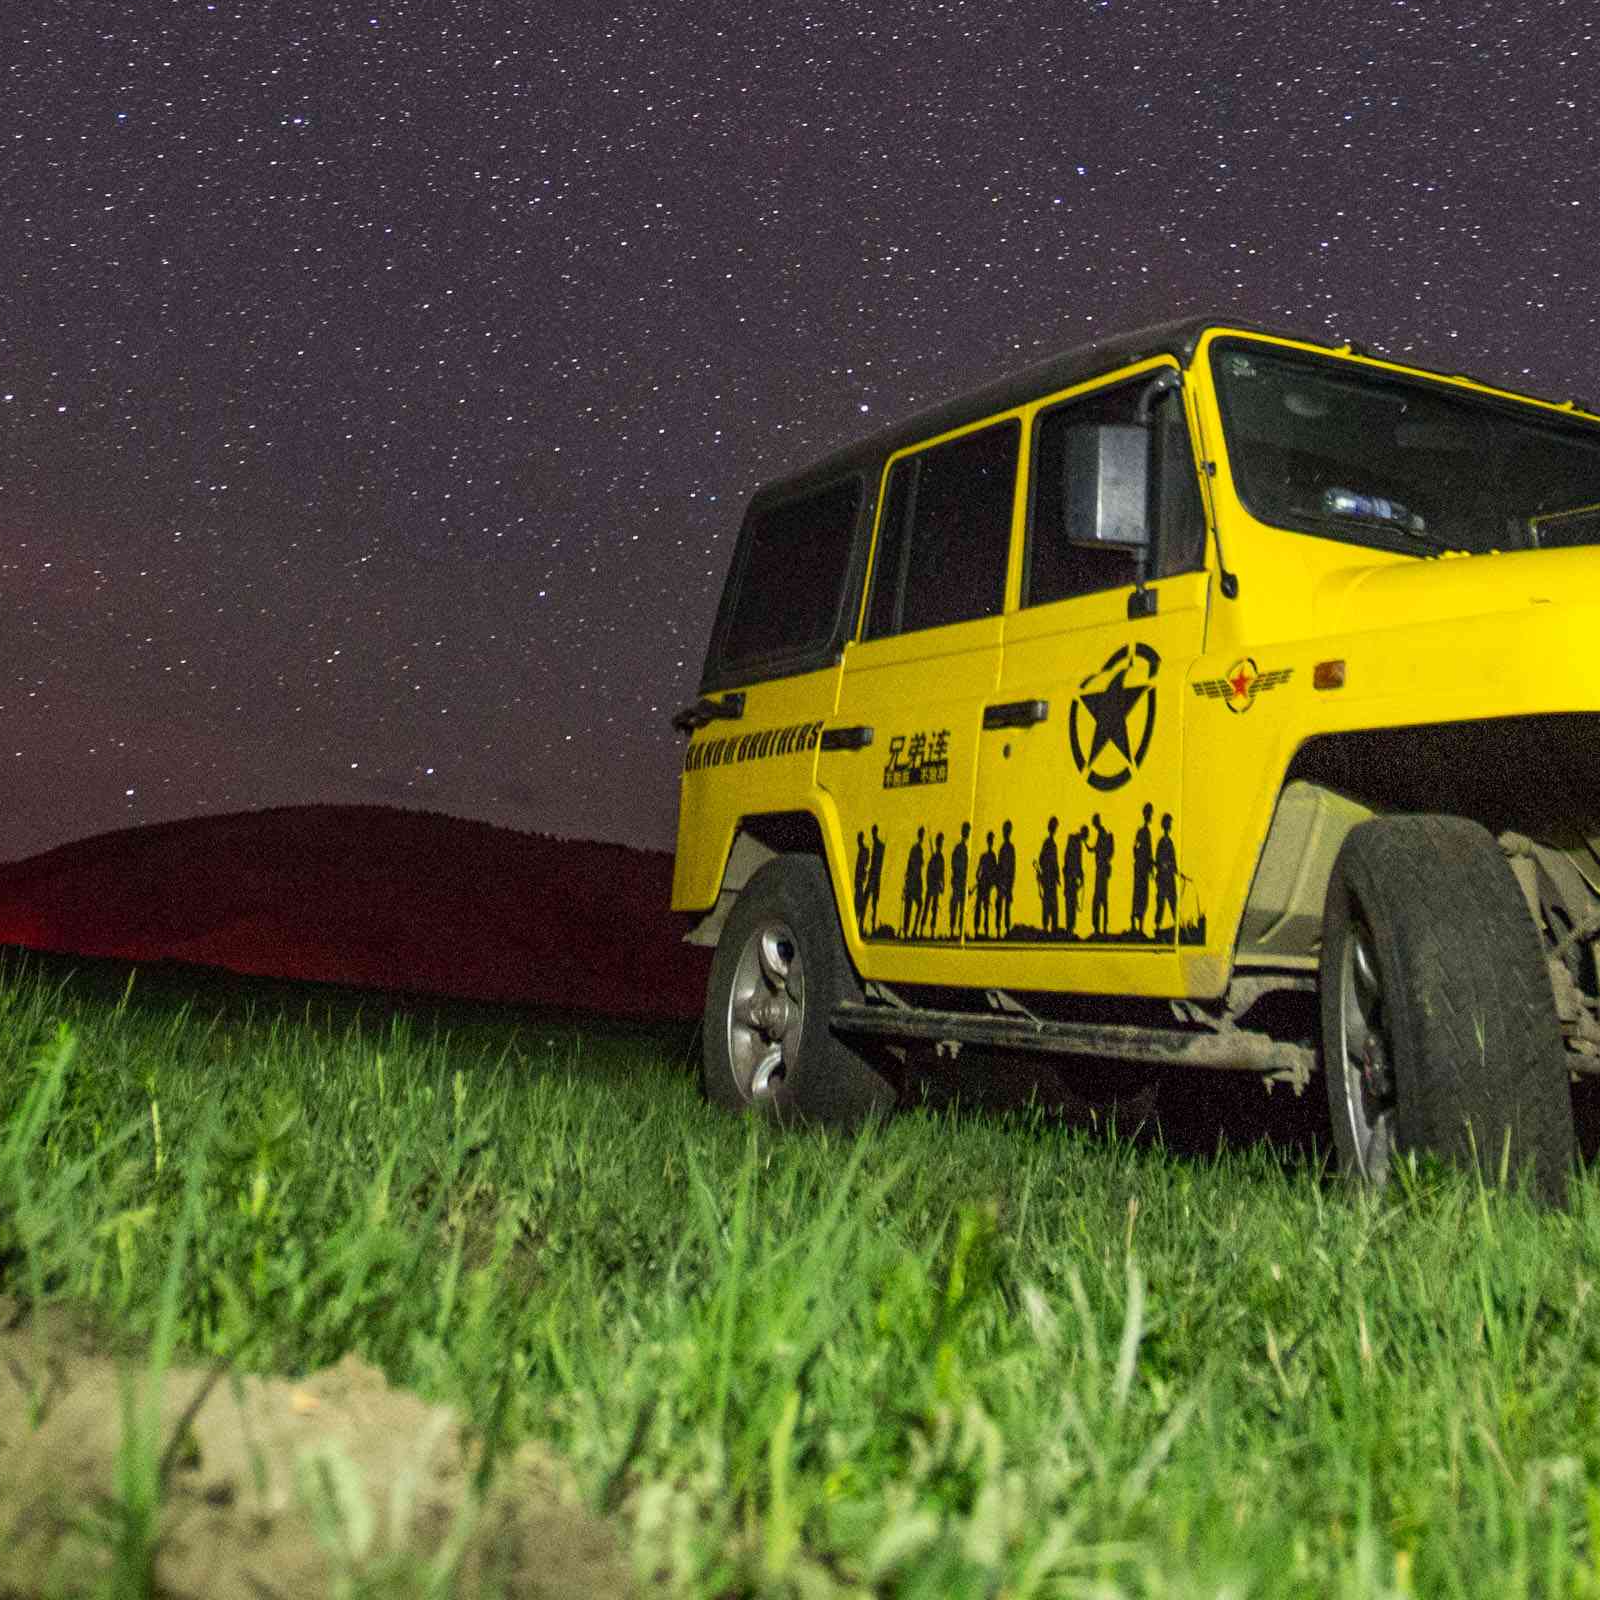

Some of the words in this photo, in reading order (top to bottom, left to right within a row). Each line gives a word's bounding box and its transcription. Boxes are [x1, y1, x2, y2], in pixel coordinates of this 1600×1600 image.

[684, 739, 725, 771] BAND
[737, 720, 824, 762] BROTHERS
[888, 730, 951, 770] 兄弟连
